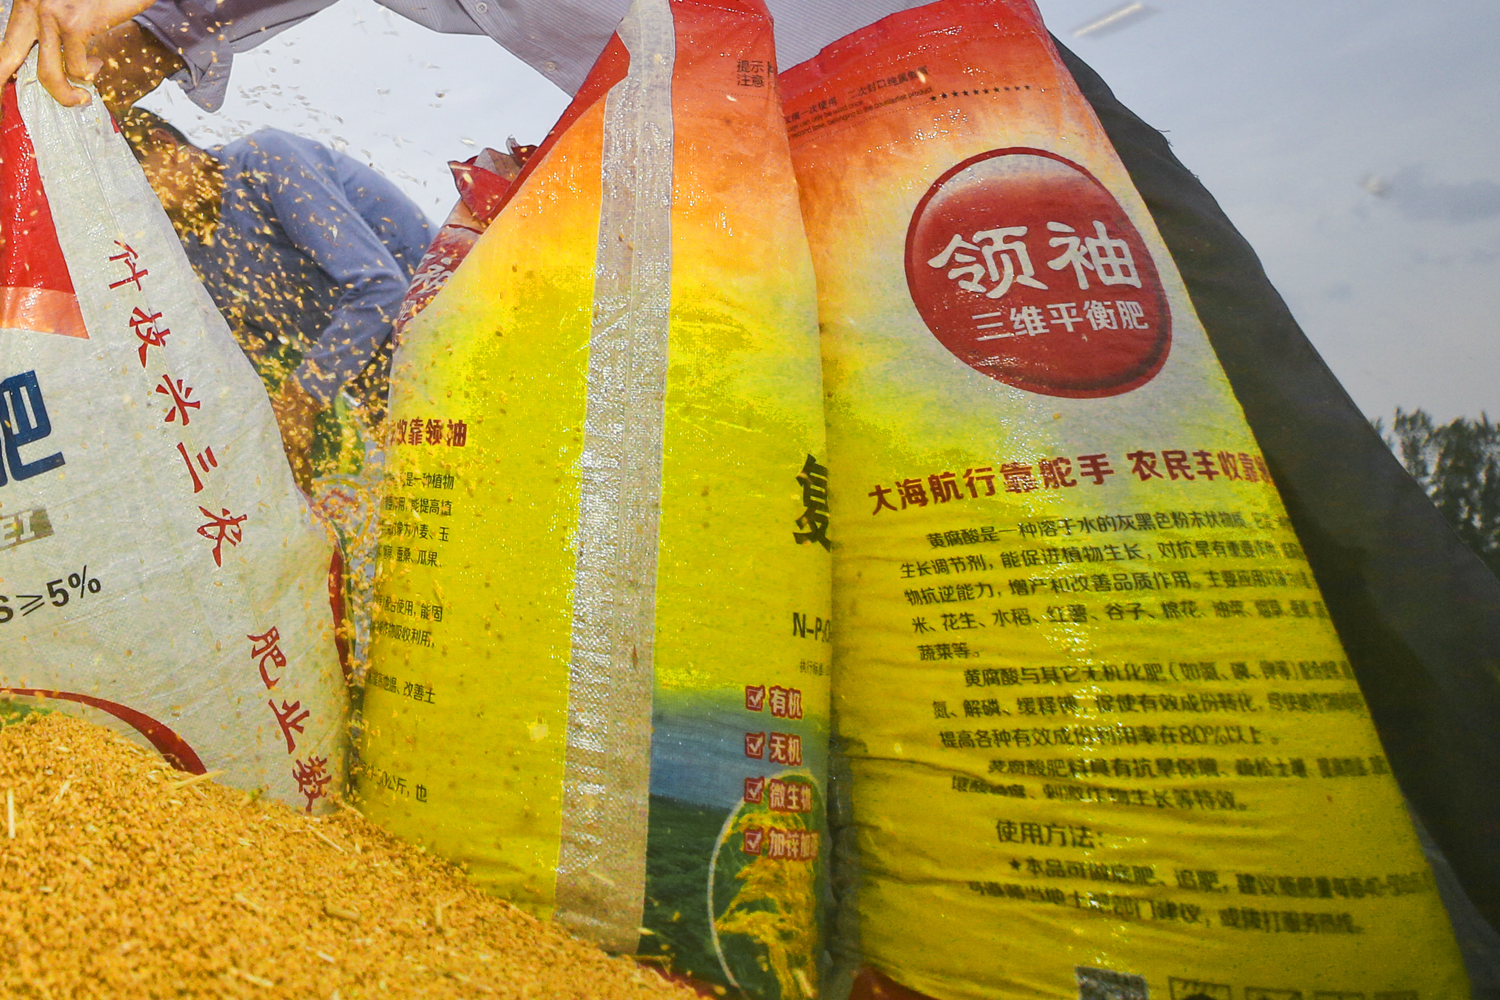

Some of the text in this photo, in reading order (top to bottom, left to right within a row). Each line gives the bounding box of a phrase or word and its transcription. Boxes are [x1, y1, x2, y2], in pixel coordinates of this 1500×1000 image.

[737, 59, 765, 74] 提示
[737, 73, 765, 88] 注意
[927, 220, 1142, 299] 领袖
[972, 300, 1150, 342] 三维平衡肥
[868, 453, 1115, 516] 大海航行靠舵手
[770, 686, 802, 718] 有机
[770, 734, 802, 765] 无机
